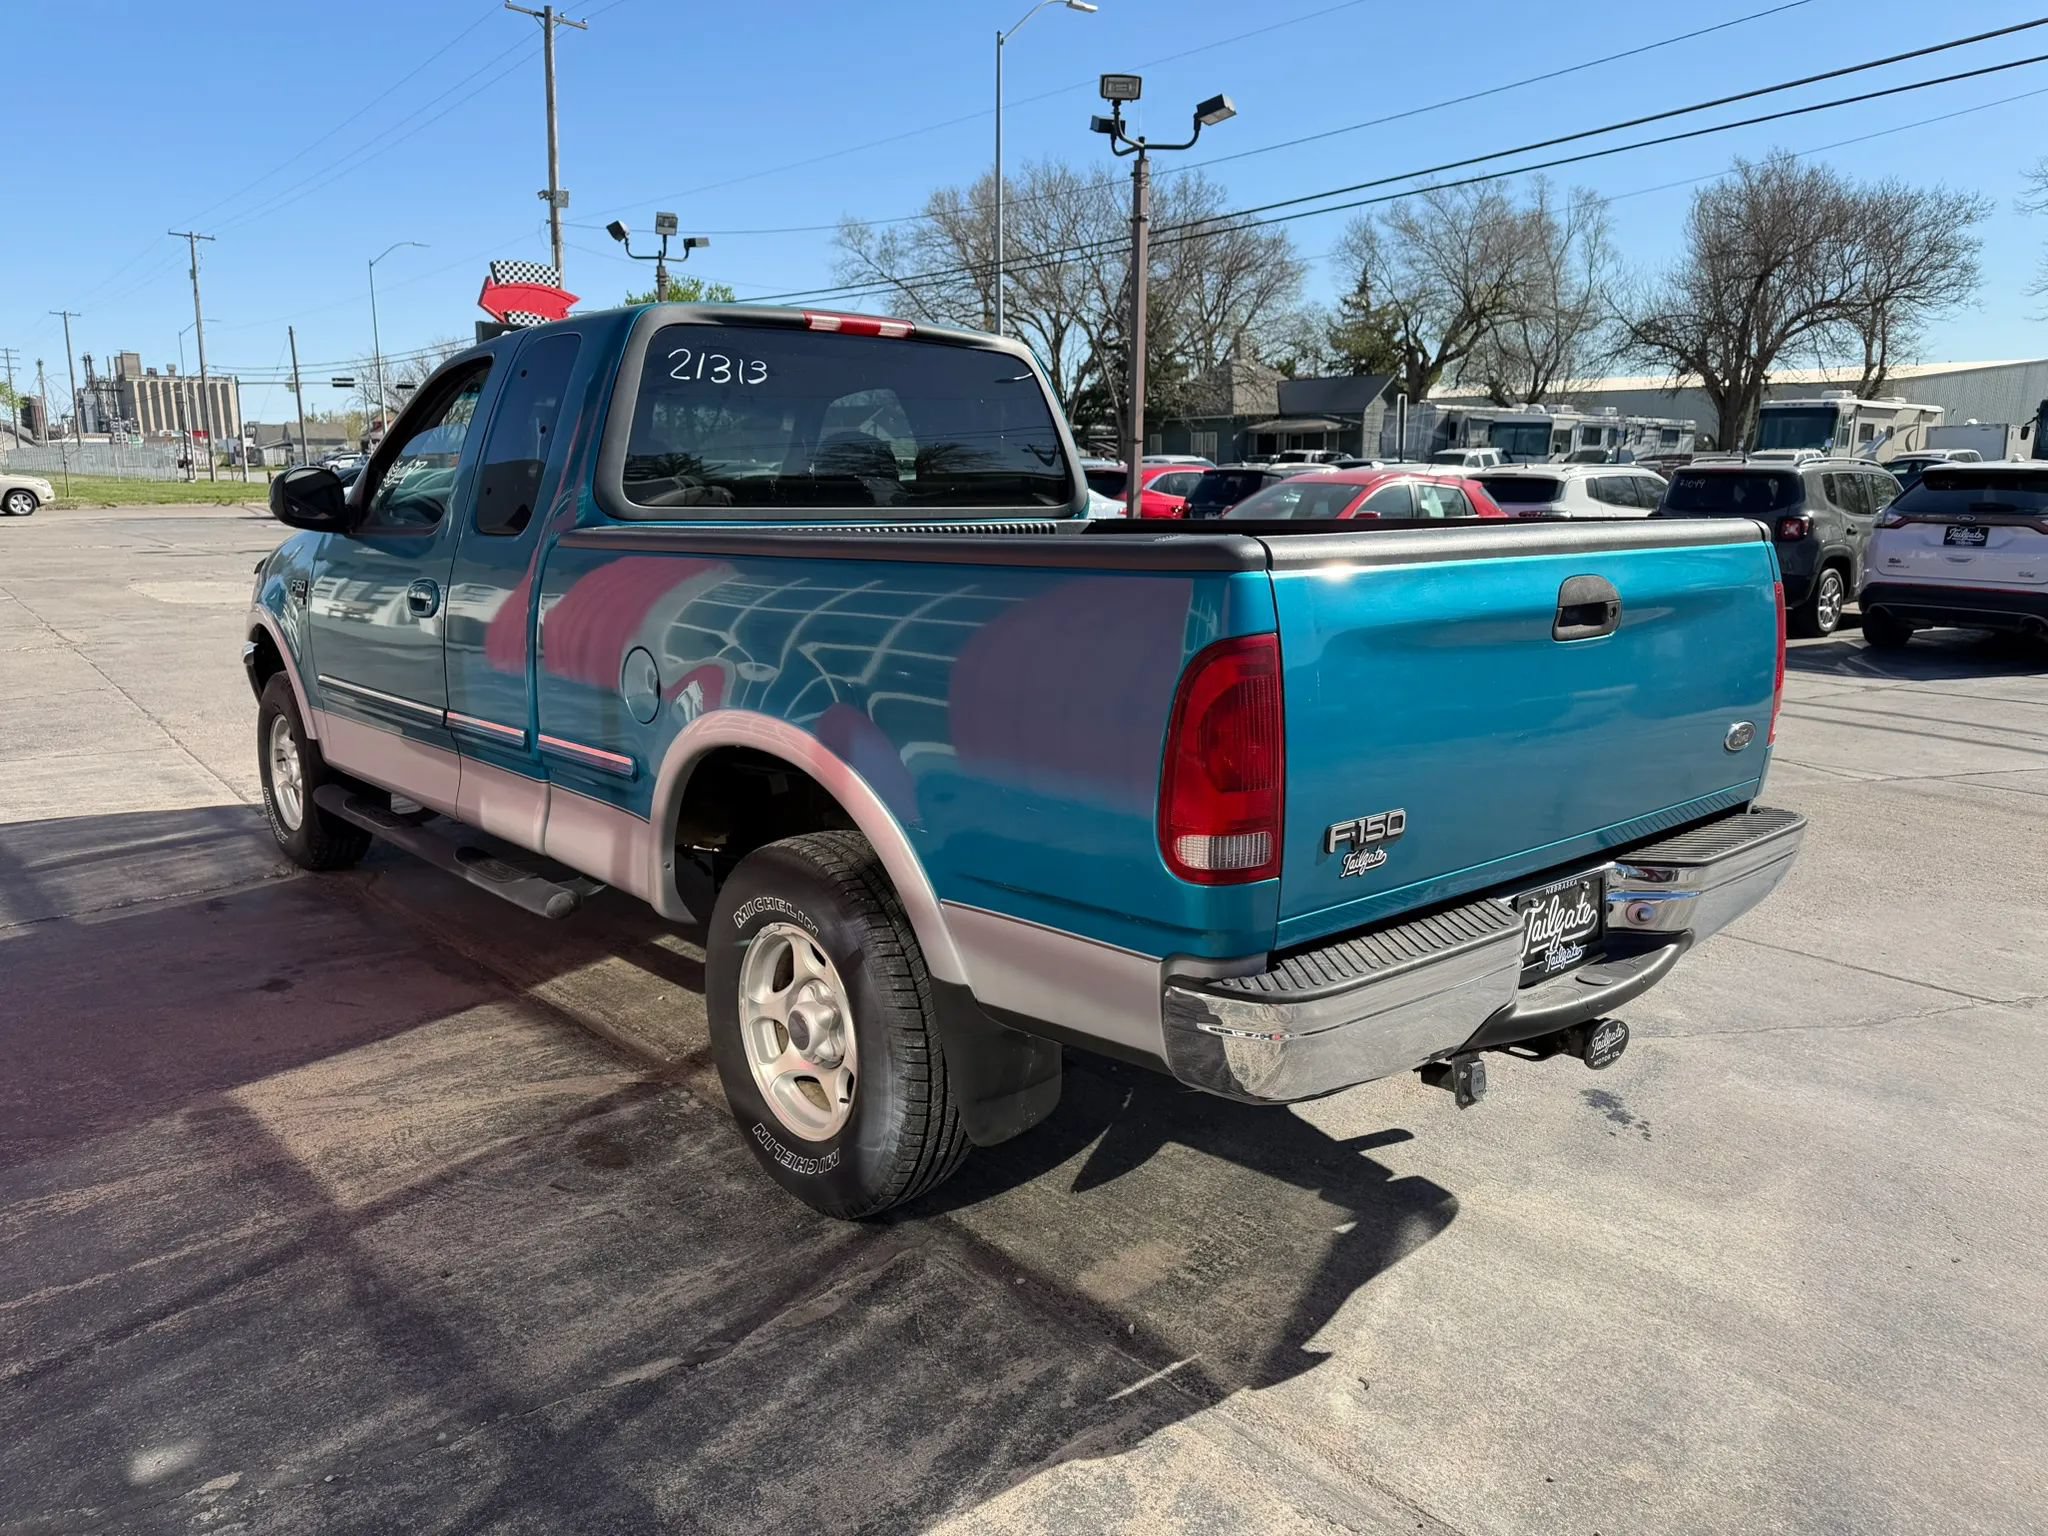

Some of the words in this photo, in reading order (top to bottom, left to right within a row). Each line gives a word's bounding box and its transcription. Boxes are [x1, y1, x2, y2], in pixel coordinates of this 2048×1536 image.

[667, 348, 768, 385] 21313
[1340, 846, 1388, 878] Tailgate
[1545, 879, 1578, 895] NEBRASKA
[733, 896, 820, 937] MICHELIN
[1520, 891, 1598, 959] Tailgate
[1544, 941, 1583, 973] Tailgate
[1590, 1022, 1626, 1059] Tailgate
[752, 1122, 841, 1175] MICHELIN
